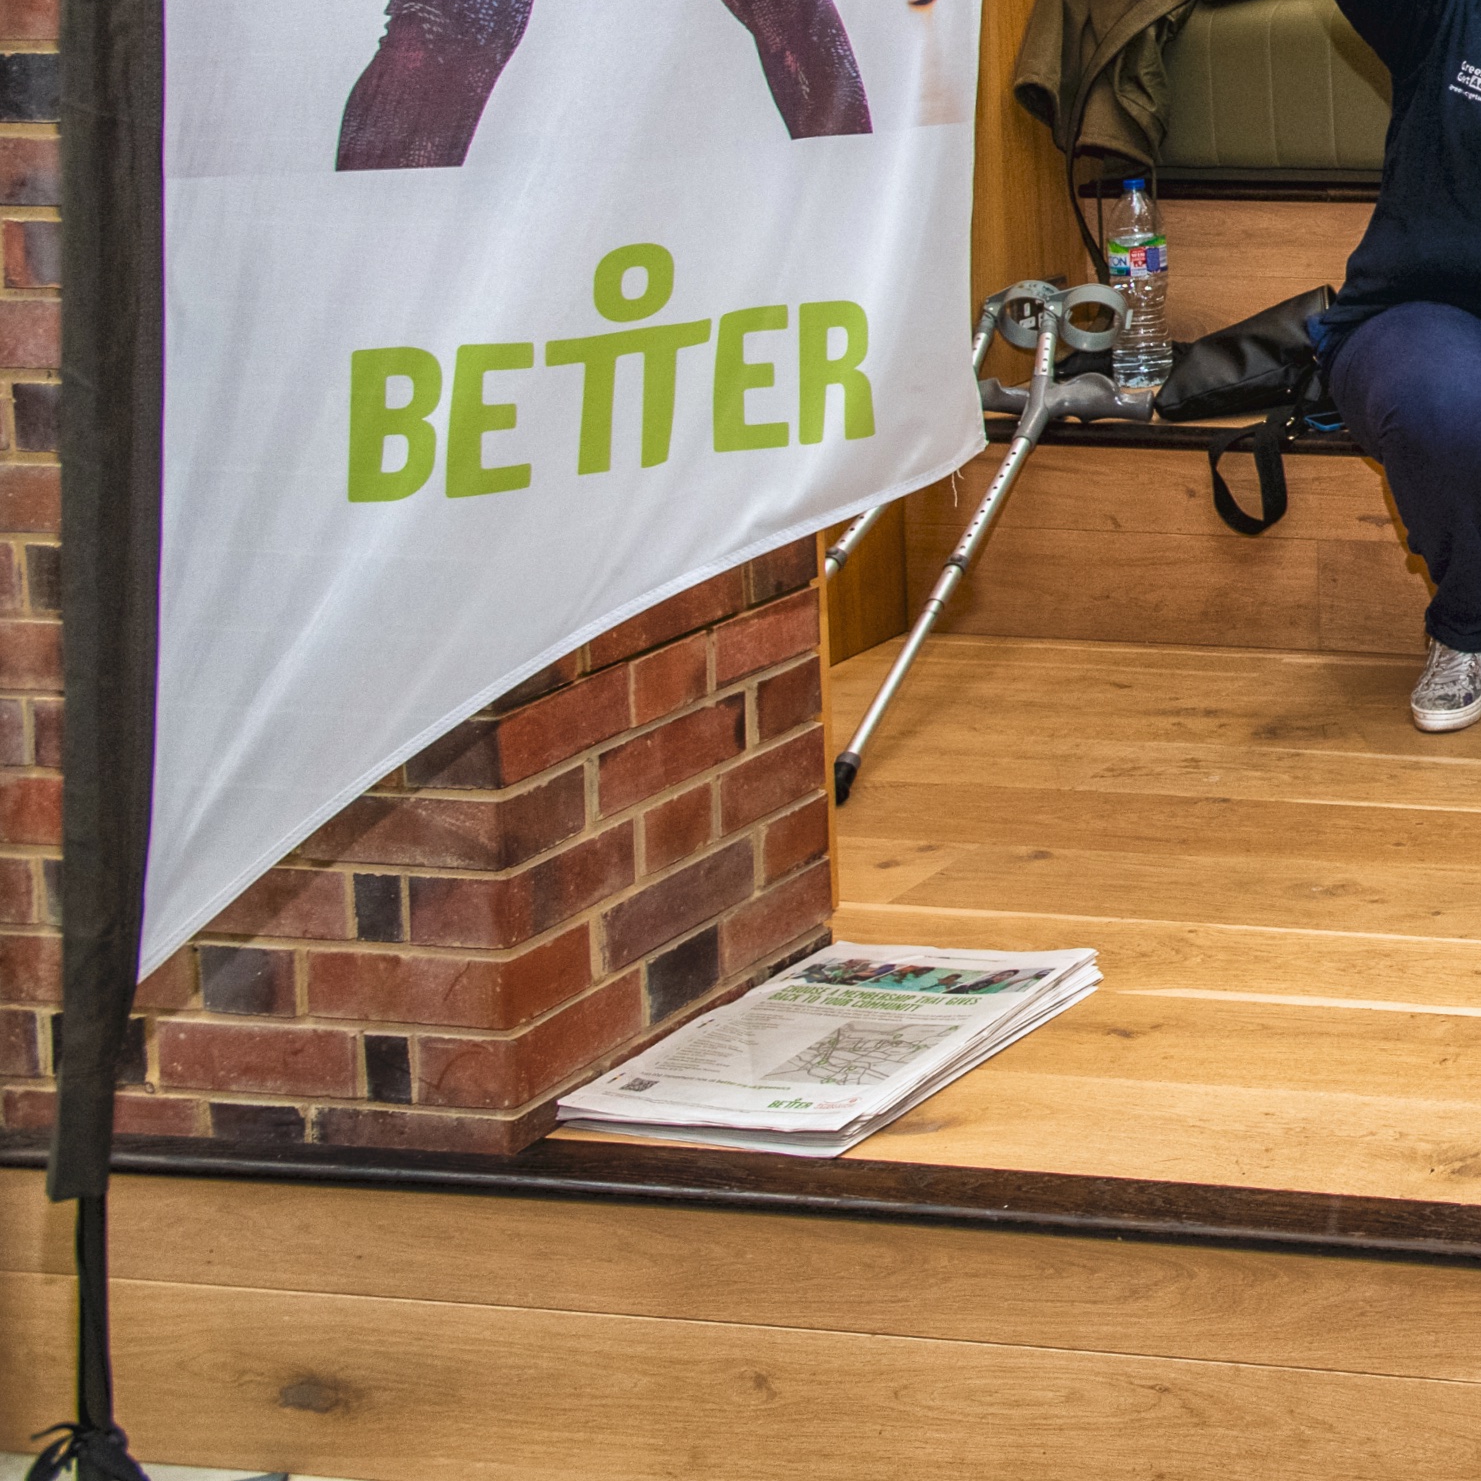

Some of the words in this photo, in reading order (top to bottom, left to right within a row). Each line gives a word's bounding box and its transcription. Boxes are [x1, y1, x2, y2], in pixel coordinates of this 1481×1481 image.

[347, 242, 876, 504] BETTER
[768, 991, 802, 1002] BACK
[801, 994, 821, 1003] TO
[820, 996, 853, 1007] YOUR
[852, 998, 925, 1012] COMMUNITY
[782, 985, 831, 996] CHOOSE
[842, 989, 916, 1002] MEMBERSHIP
[915, 995, 945, 1005] THAT
[944, 996, 982, 1006] GIVES
[767, 1097, 813, 1109] BETTER
